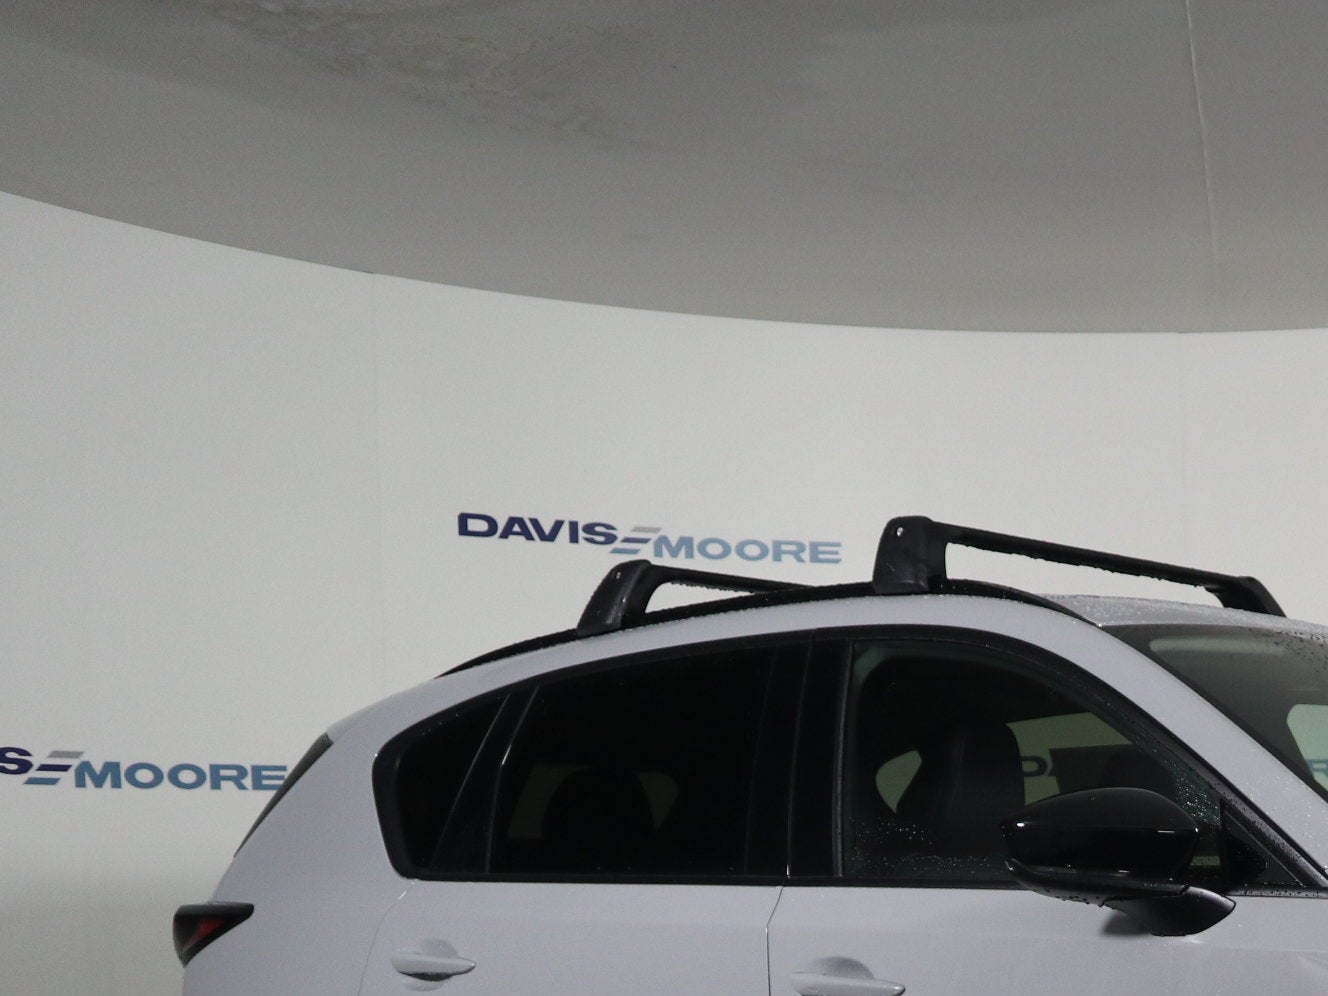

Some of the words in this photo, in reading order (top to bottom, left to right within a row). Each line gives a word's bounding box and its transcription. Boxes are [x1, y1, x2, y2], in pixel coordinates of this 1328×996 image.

[457, 512, 619, 546] DAVIS
[653, 535, 842, 564] MOORE
[75, 761, 287, 790] MOORE
